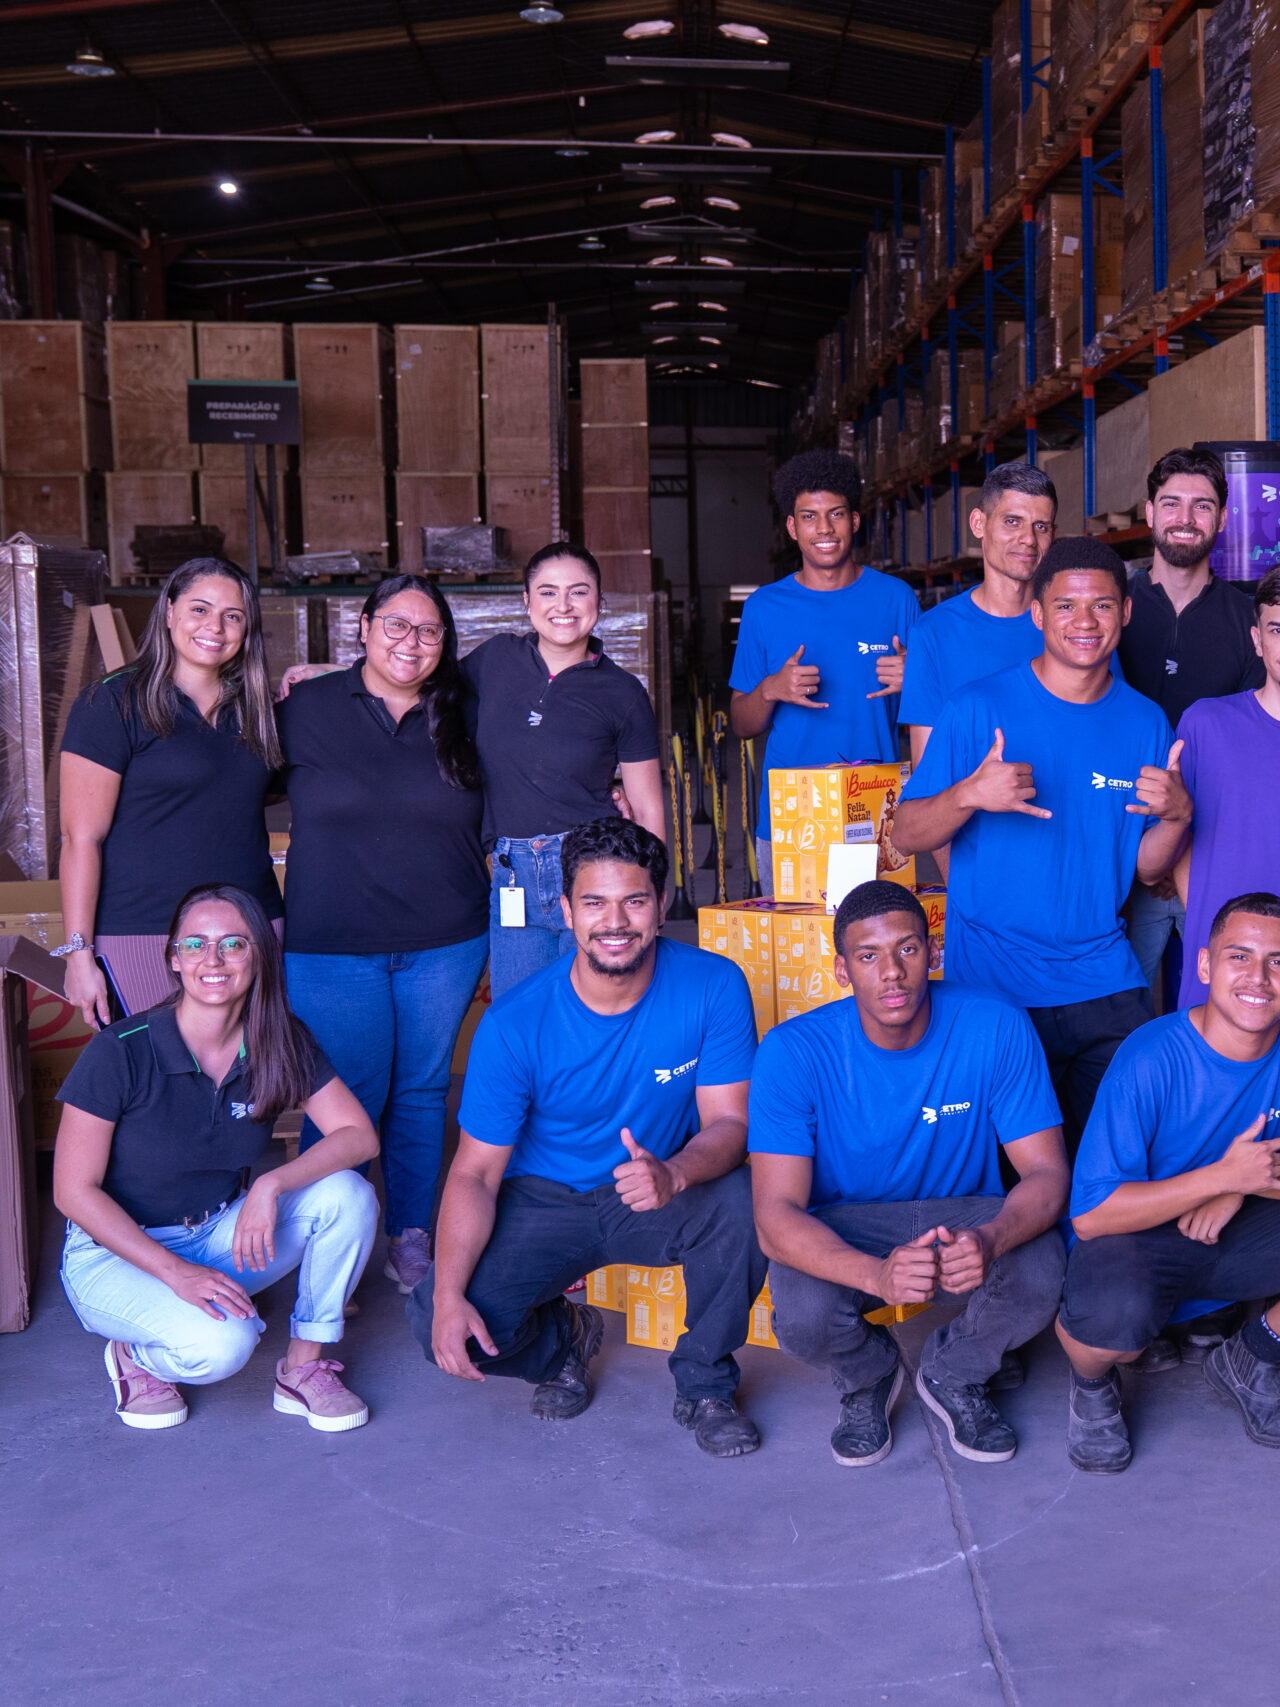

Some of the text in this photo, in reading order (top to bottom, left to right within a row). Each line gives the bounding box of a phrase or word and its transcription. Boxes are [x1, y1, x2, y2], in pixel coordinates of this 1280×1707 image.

[206, 401, 280, 412] PREPARAÇÃO E
[209, 411, 278, 421] RECEBIMENTO
[846, 769, 897, 799] Bauducco
[1107, 778, 1133, 789] CETRO
[847, 801, 866, 813] Feliz
[673, 1056, 699, 1075] CETR
